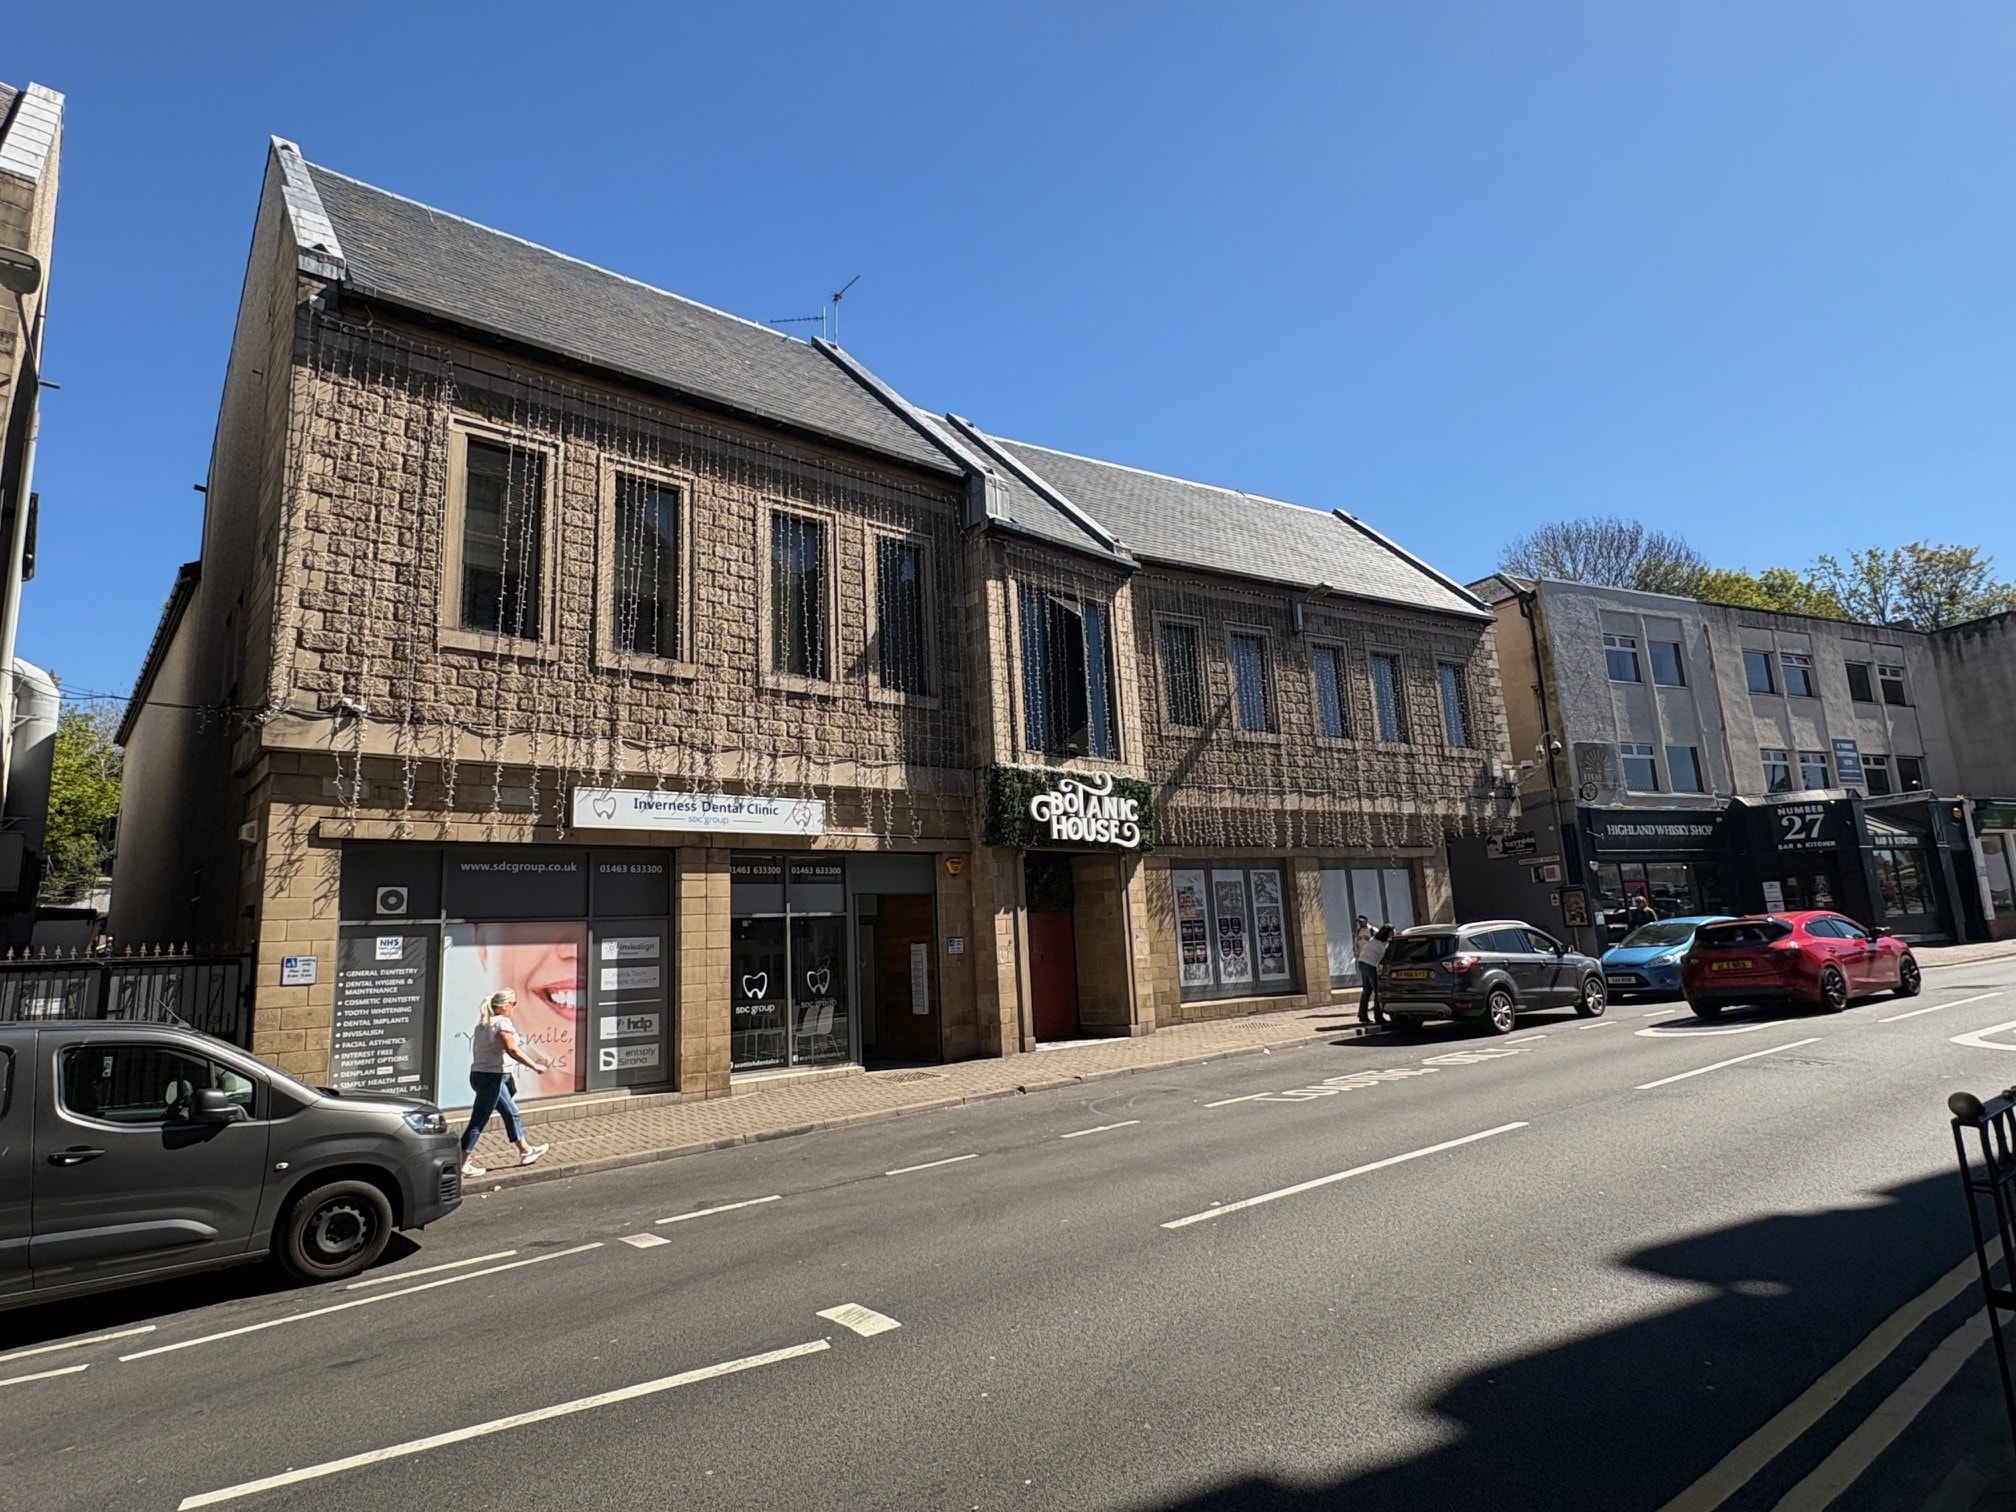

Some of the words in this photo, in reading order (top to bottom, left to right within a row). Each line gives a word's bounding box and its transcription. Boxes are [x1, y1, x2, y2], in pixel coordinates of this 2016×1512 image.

[1030, 771, 1139, 822] BOTANIC
[634, 797, 696, 812] Inverness
[702, 801, 743, 814] Dental
[747, 803, 779, 816] Clinic
[1777, 805, 1824, 815] NUMBER
[704, 815, 730, 825] group
[1051, 814, 1140, 848] HOUSE
[1606, 824, 1655, 835] HIGHLAND
[1655, 825, 1690, 835] WHISKY
[1690, 825, 1713, 835] SHOP
[1781, 814, 1825, 840] 27
[1805, 840, 1836, 848] KITCHEN
[460, 861, 577, 874] www.sdcgroup.co.uk
[600, 864, 628, 873] 01463
[630, 865, 663, 874] 633300
[753, 866, 781, 874] 633300
[791, 866, 813, 874] 01463
[816, 867, 841, 875] 633300
[380, 939, 400, 947] NHS
[620, 943, 655, 952] invisalign
[345, 987, 398, 995] MAINTENANCE
[344, 998, 380, 1006] COSMETIC
[382, 996, 420, 1004] DENTISTRY
[344, 1008, 369, 1016] TOOTH
[371, 1006, 412, 1014] WHITENING
[751, 1004, 775, 1015] group
[343, 1019, 371, 1027] DENTAL
[373, 1017, 409, 1025] IMPLANTS
[627, 1017, 653, 1032] hdp
[342, 1029, 384, 1038] INVISALIGN
[518, 1027, 573, 1046] smile,
[369, 1037, 406, 1046] ASTHETICS
[341, 1050, 375, 1059] INTEREST
[341, 1058, 375, 1067] PAYMENT
[377, 1055, 409, 1064] OPTIONS
[618, 1056, 648, 1066] Sirona
[340, 1069, 375, 1078] DENPLAN
[340, 1080, 366, 1089] SIMPLY
[368, 1077, 396, 1086] HEALTH
